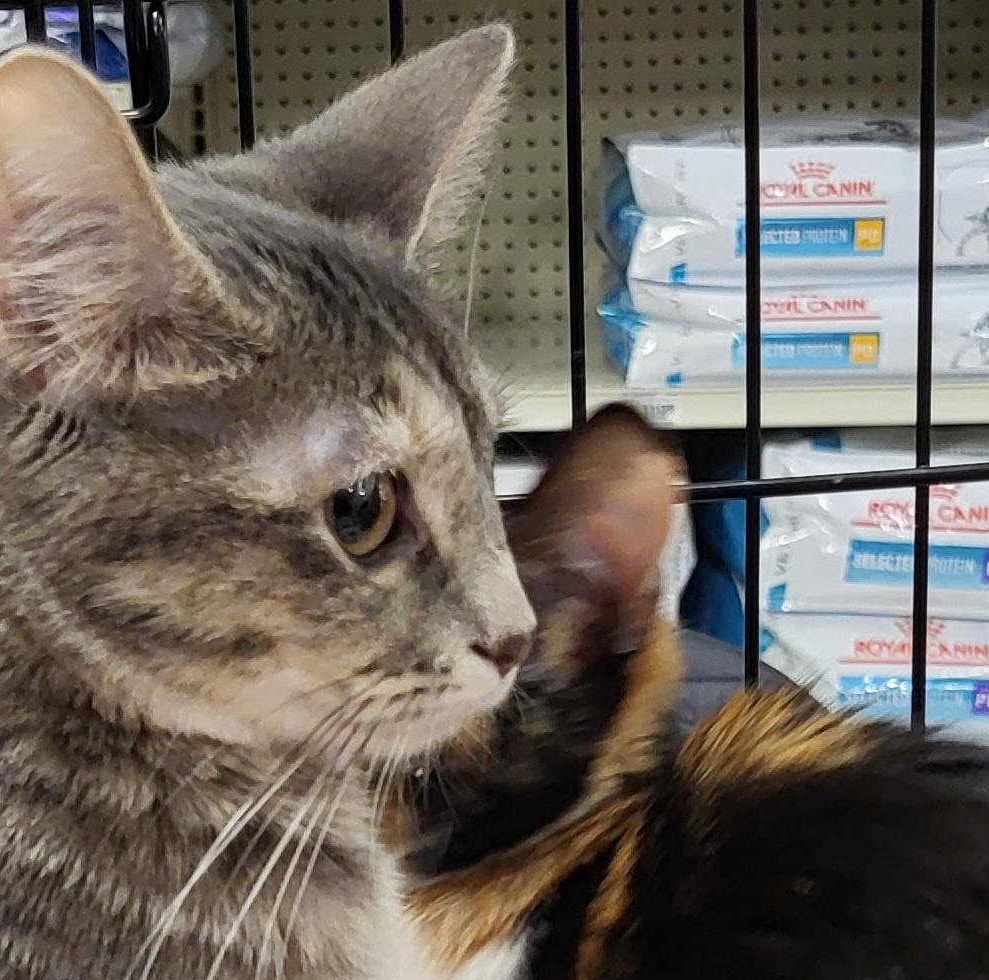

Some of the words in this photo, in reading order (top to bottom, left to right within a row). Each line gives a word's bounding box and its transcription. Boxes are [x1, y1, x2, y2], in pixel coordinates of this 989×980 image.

[813, 181, 872, 198] CANIN
[808, 297, 866, 313] CANIN
[937, 504, 989, 524] CANI
